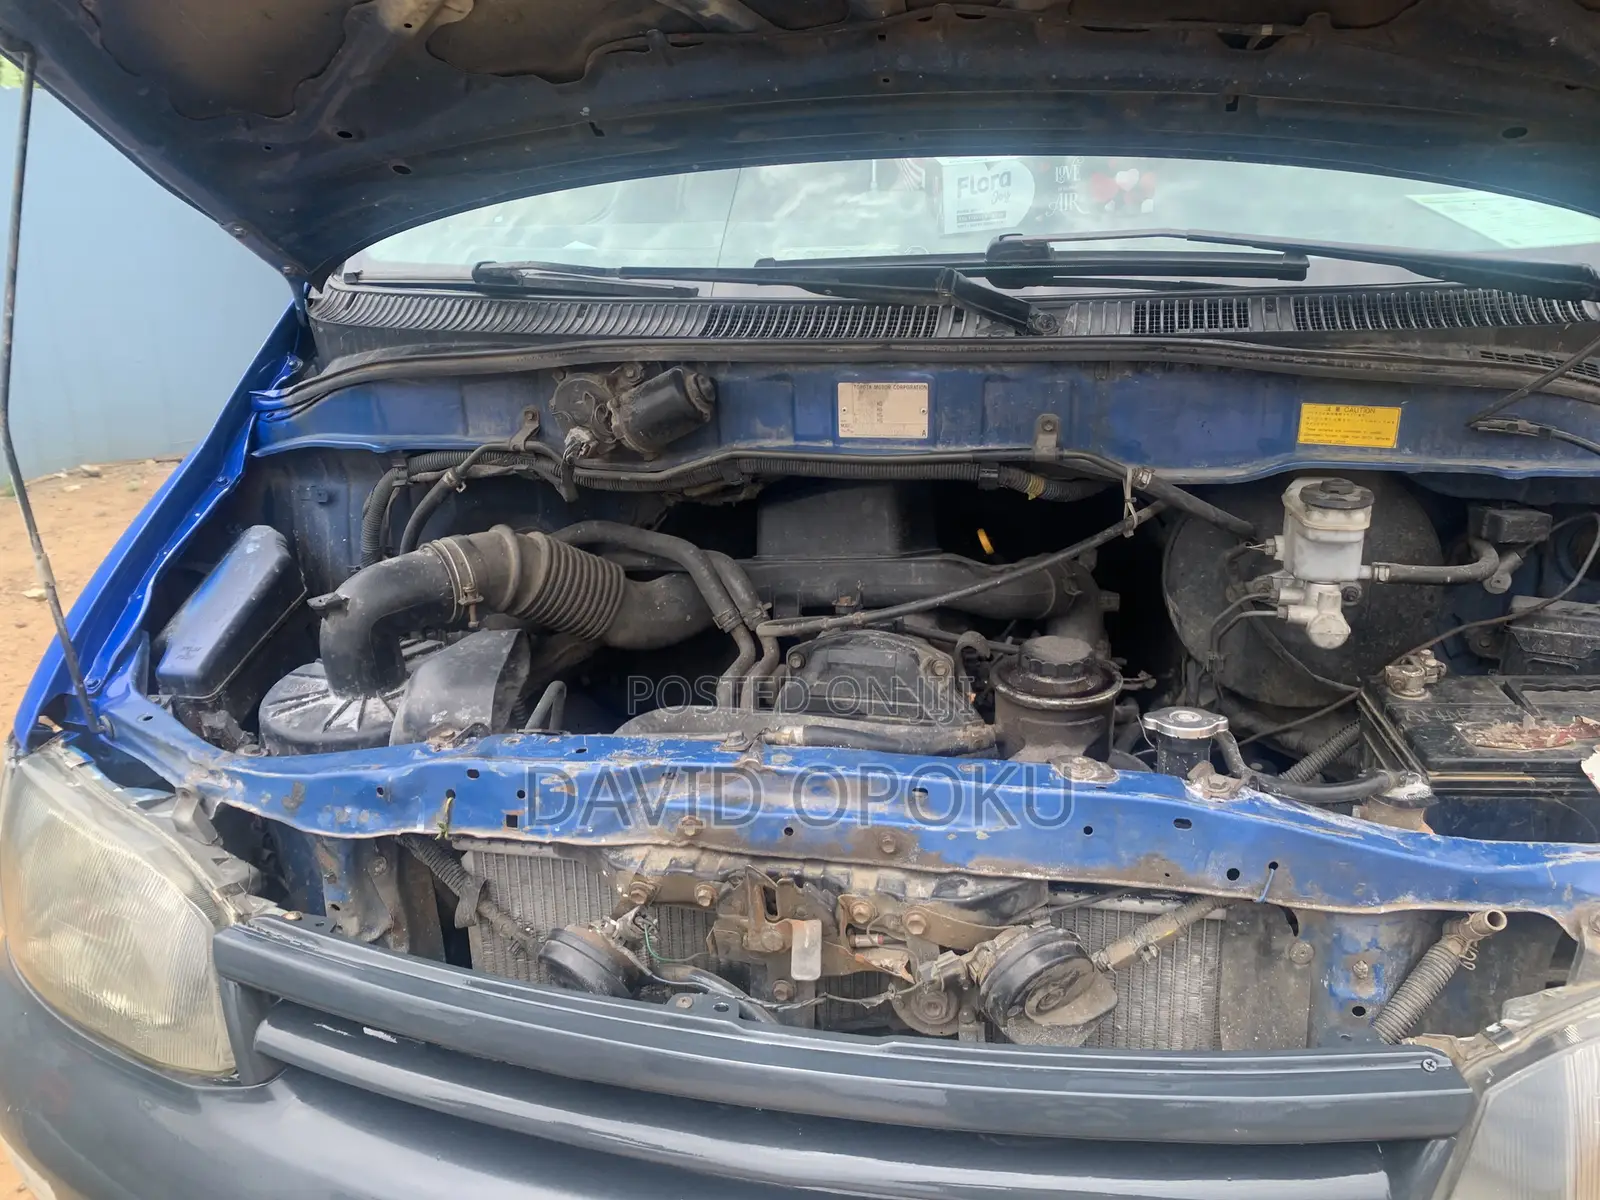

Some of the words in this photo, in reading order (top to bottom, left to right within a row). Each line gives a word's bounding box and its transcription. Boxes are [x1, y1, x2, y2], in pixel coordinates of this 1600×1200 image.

[1055, 157, 1083, 183] LOVE
[1045, 192, 1090, 216] AIR
[1344, 406, 1376, 414] CAUTION
